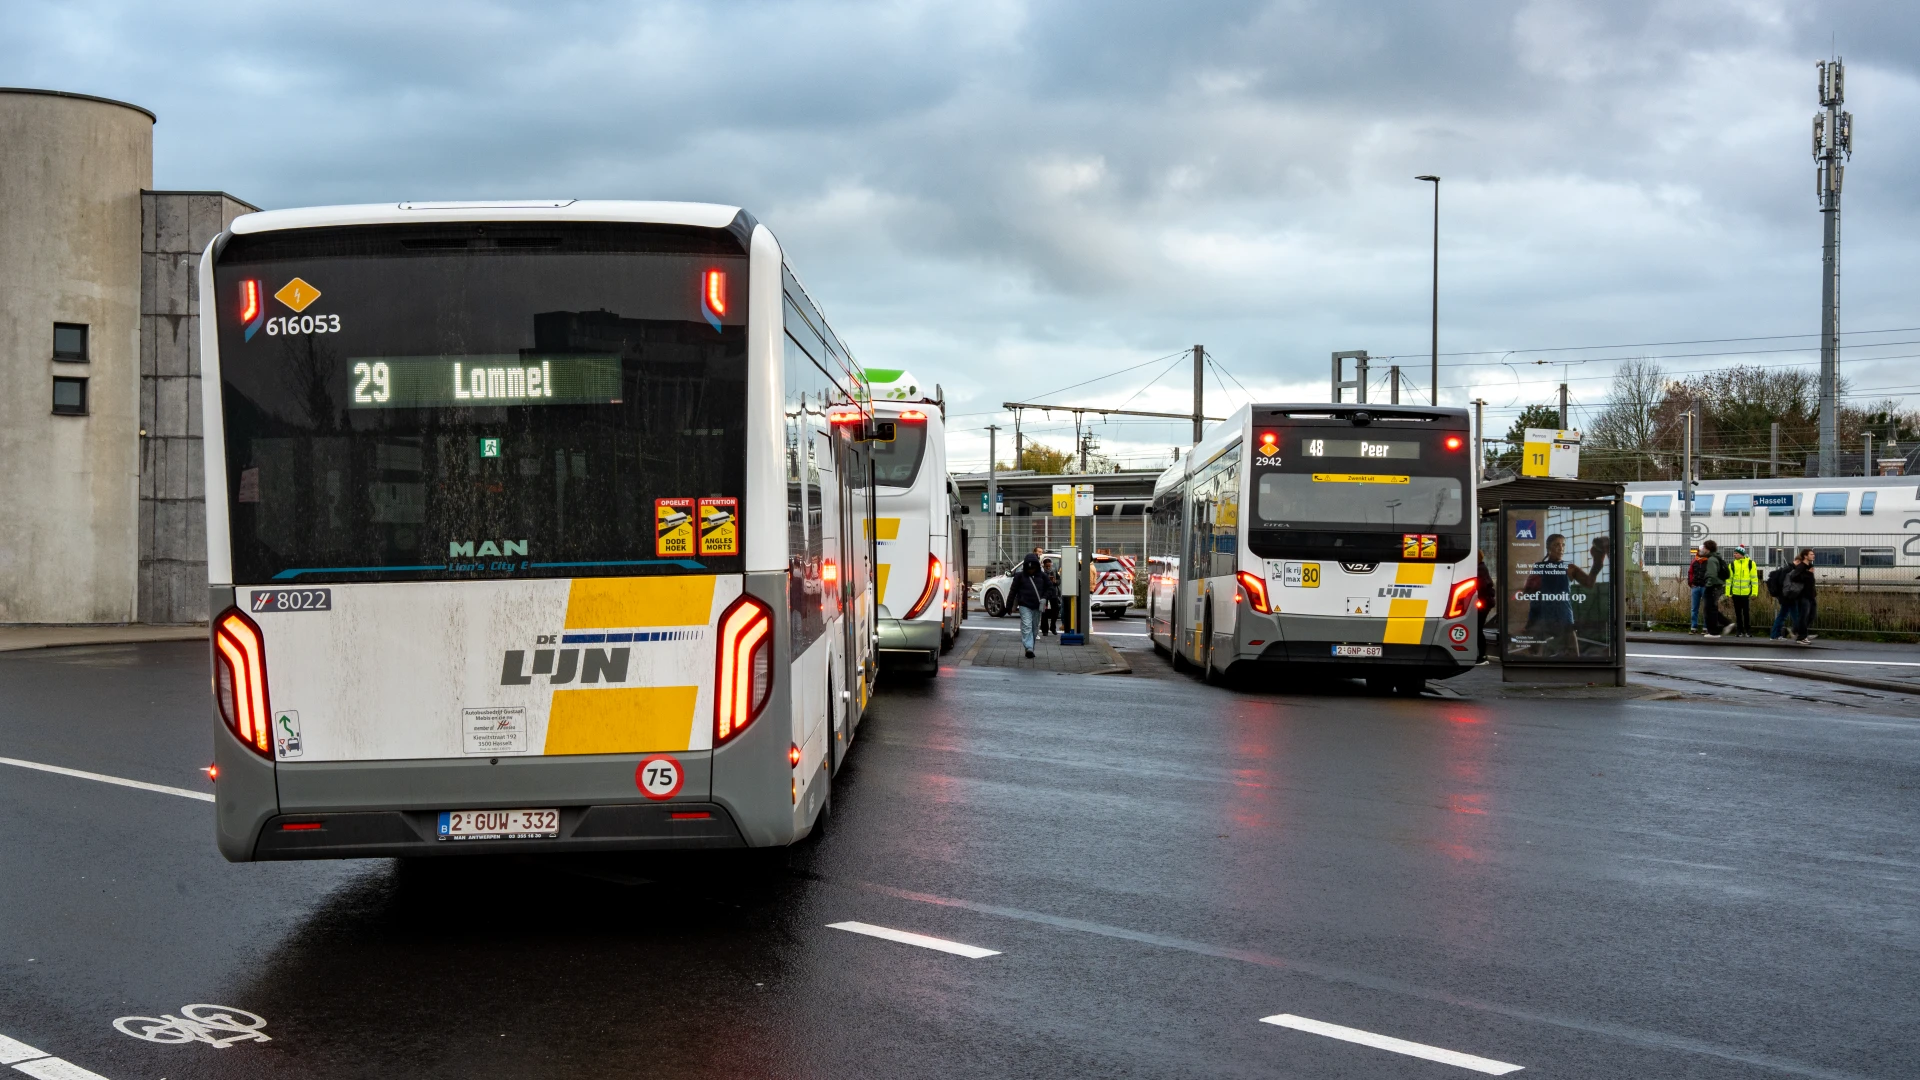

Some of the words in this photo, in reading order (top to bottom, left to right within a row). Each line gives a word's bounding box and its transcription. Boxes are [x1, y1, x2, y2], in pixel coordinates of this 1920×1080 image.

[266, 314, 341, 336] 616053
[354, 362, 390, 402] 29
[454, 361, 552, 399] Lommel
[1309, 440, 1324, 457] 48
[1361, 441, 1389, 457] Peer
[1255, 457, 1282, 466] 2942
[1532, 454, 1545, 466] 11
[1057, 501, 1068, 509] 10
[1759, 497, 1787, 505] Hasselt
[1516, 529, 1533, 538] AXA
[450, 540, 528, 557] MAN
[449, 562, 485, 571] Lion's
[490, 561, 515, 572] City
[521, 561, 529, 570] E
[1346, 563, 1371, 571] VDL
[1302, 568, 1319, 583] 80
[1378, 588, 1413, 598] LIJN
[1515, 591, 1541, 601] Geef
[1541, 591, 1570, 601] nooit
[1571, 593, 1587, 603] op
[277, 591, 327, 609] 8022
[1453, 629, 1465, 637] 75
[536, 635, 558, 645] DE
[501, 647, 631, 686] LIJN
[647, 768, 673, 786] 75
[441, 825, 448, 833] B
